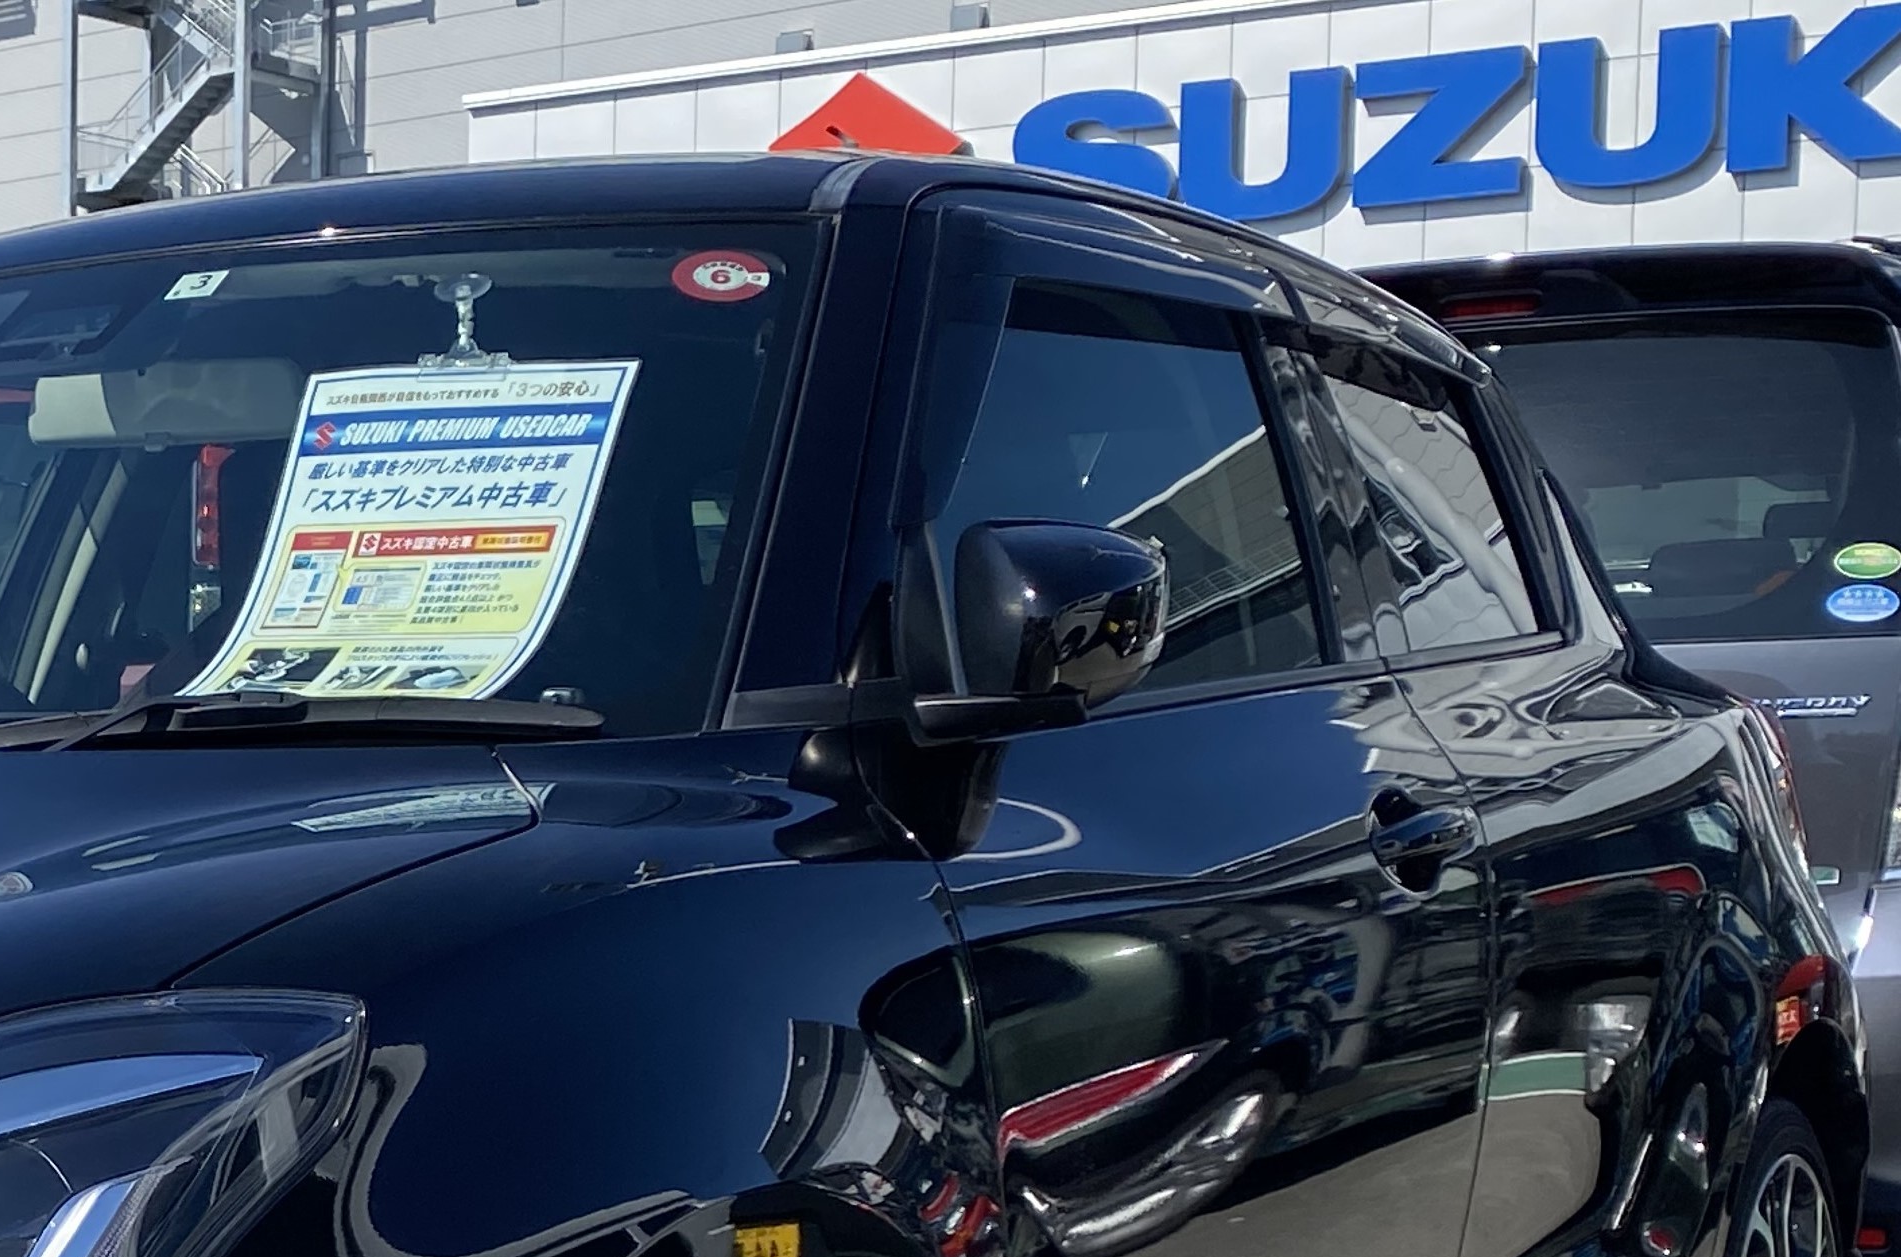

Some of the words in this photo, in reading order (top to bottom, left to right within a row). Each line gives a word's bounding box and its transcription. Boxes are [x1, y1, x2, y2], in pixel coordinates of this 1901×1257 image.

[710, 269, 731, 284] 6
[340, 420, 409, 446] SUZUKI
[407, 417, 501, 442] PREMIUM
[500, 414, 593, 438] USEDCAR
[308, 452, 574, 480] 厳しい基準をクリアした特別な中古車
